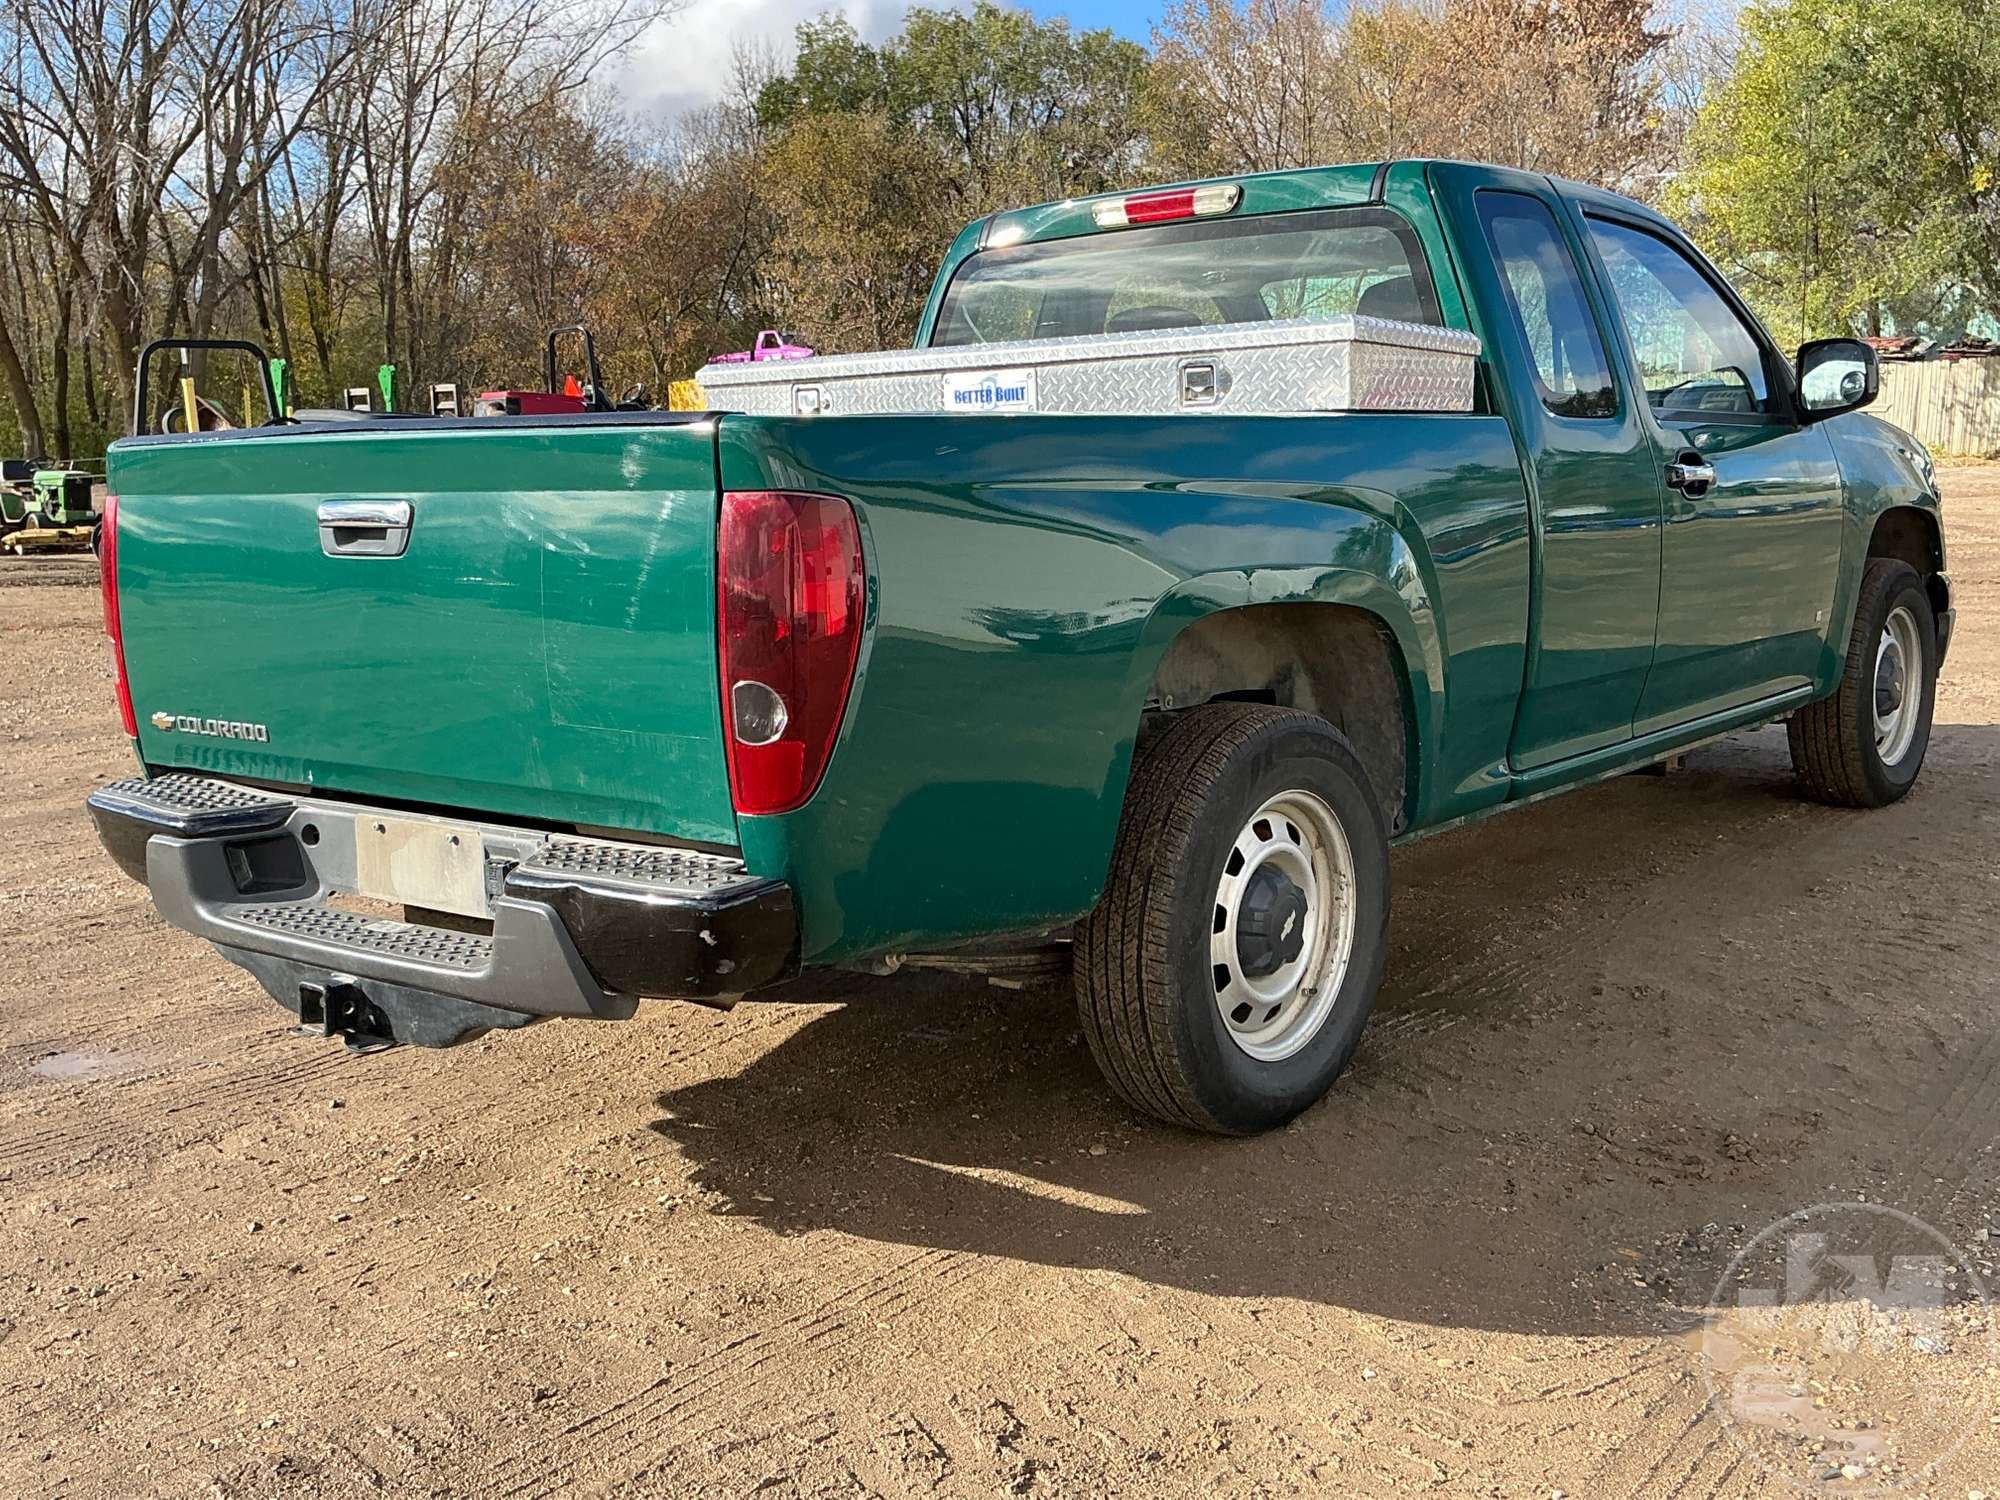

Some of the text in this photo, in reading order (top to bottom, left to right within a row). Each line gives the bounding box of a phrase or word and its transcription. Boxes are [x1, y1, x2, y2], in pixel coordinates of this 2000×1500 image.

[954, 386, 1026, 404] BETTER BUILT
[176, 715, 269, 743] COLORADO
